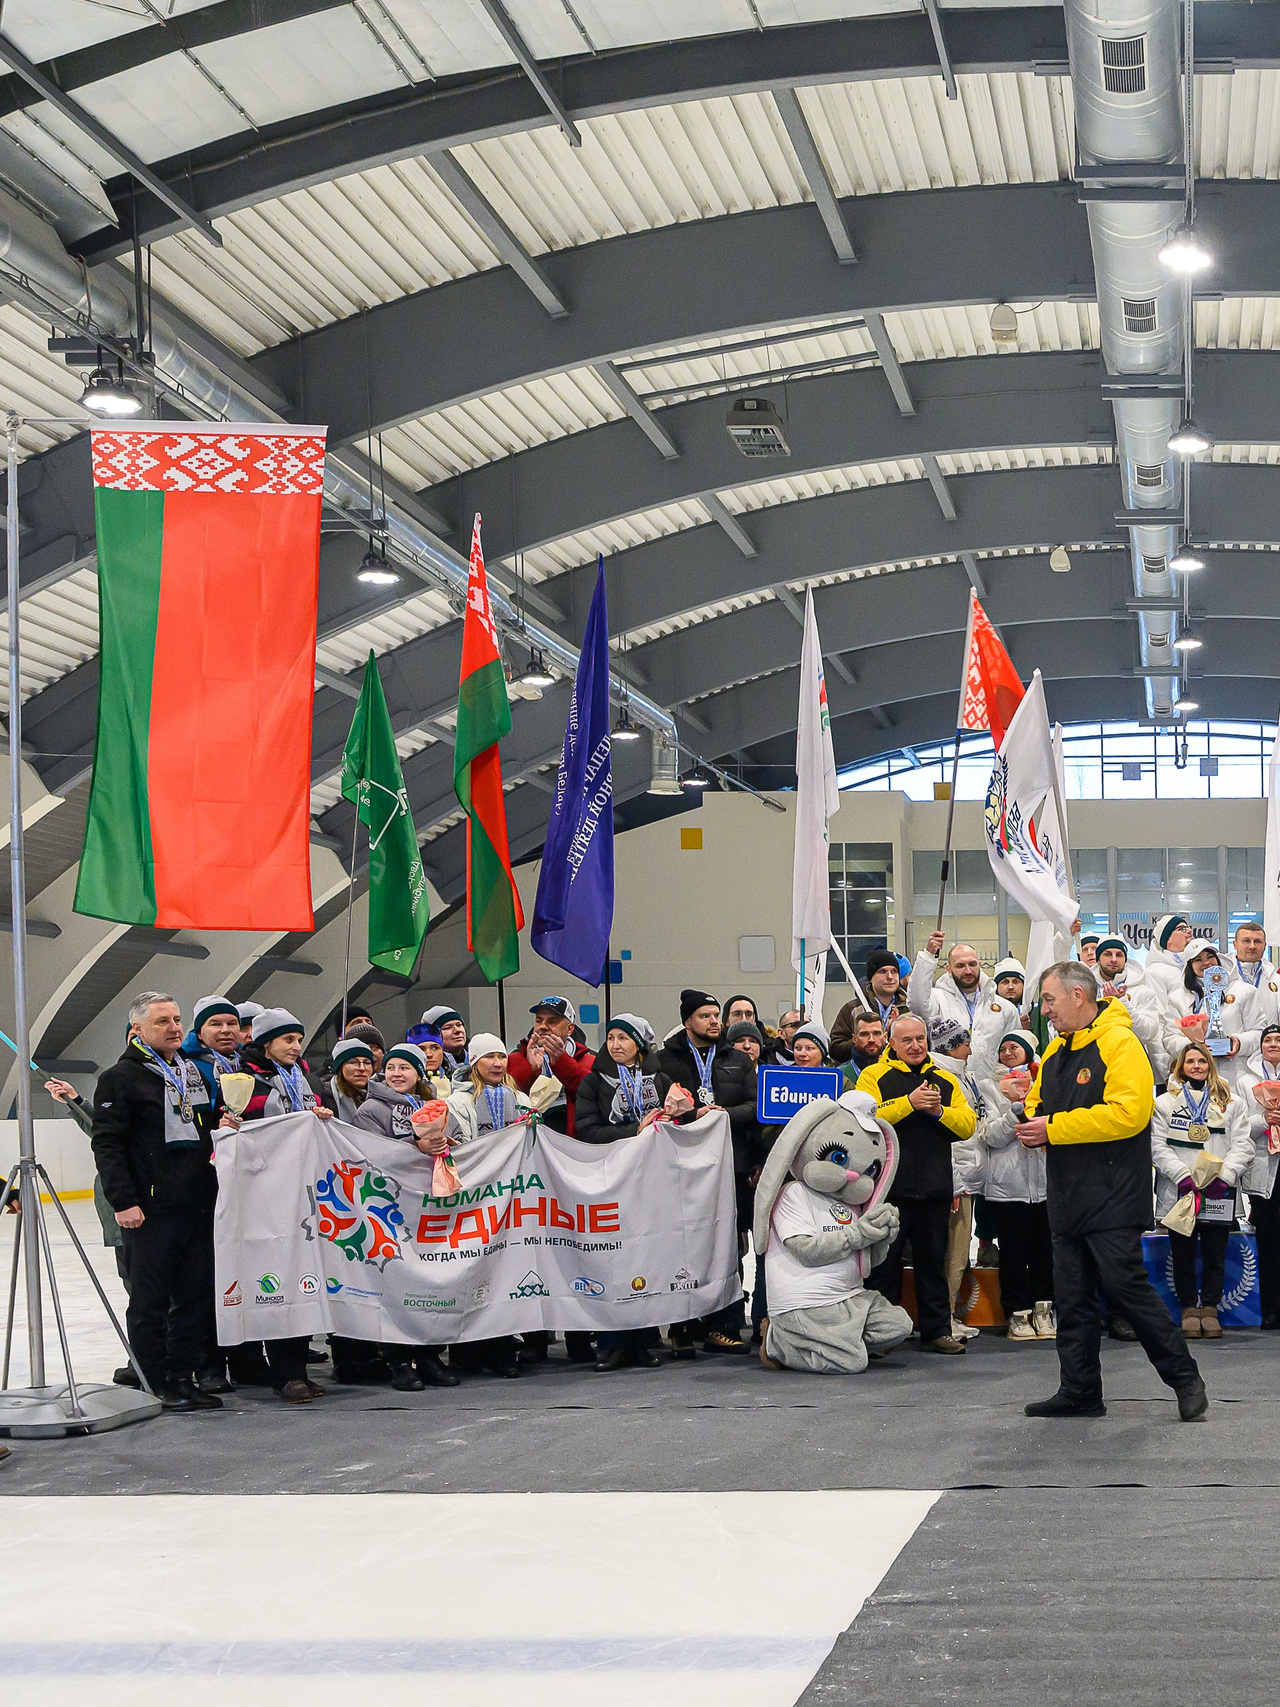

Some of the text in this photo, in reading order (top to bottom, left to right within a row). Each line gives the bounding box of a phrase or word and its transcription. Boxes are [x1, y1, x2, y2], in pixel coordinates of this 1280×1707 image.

[422, 1173, 545, 1208] КОМАНДА
[416, 1197, 620, 1249] ЕДИНЫЕ
[419, 1252, 456, 1263] КОГДА
[460, 1248, 481, 1260] МЫ
[483, 1238, 507, 1256] ЕДИНЫ
[524, 1236, 542, 1246] МЫ
[544, 1237, 624, 1253] НЕПОБЕДИМЫ!
[403, 1298, 456, 1307] ВОСТОЧНЫЙ
